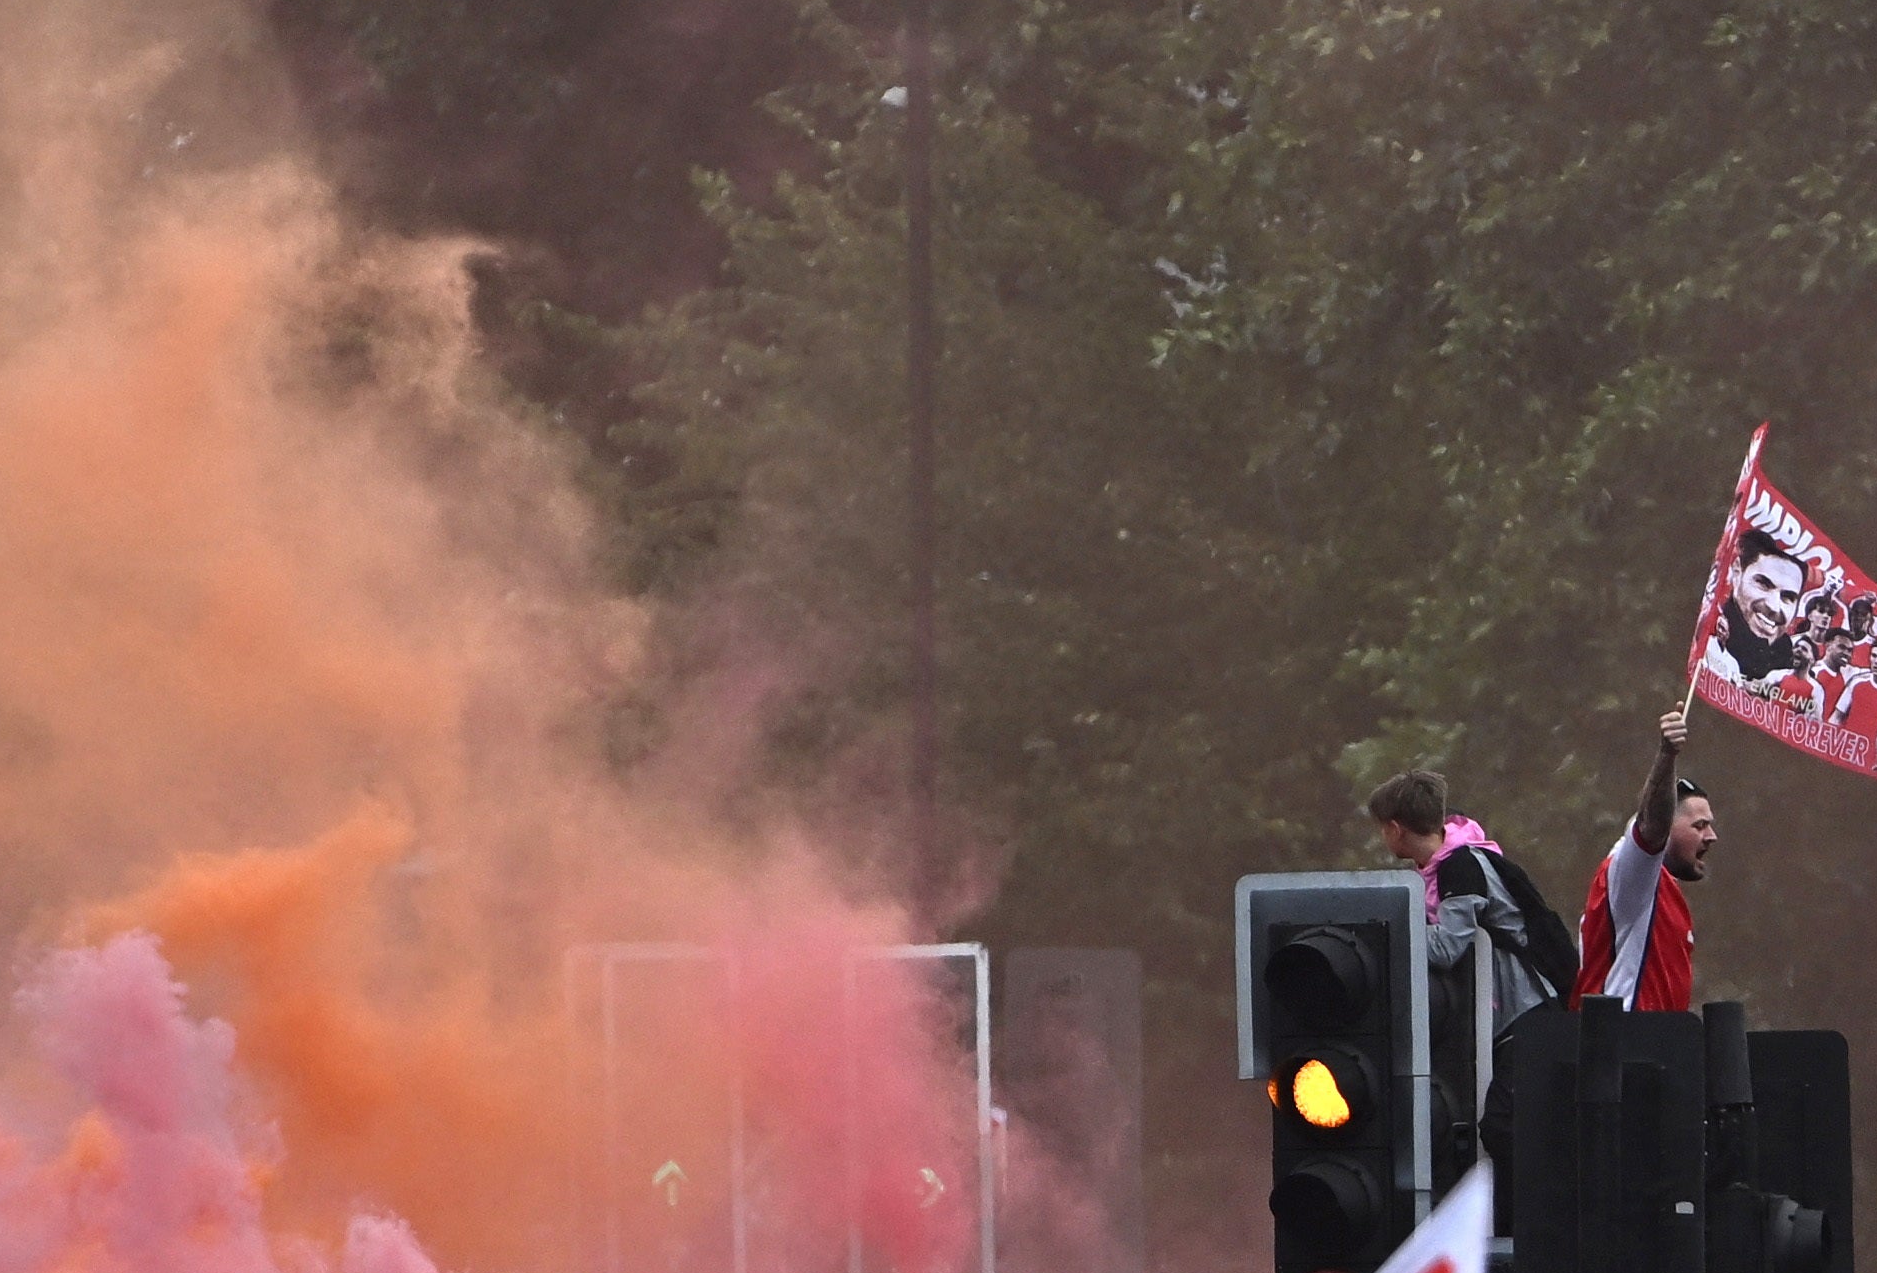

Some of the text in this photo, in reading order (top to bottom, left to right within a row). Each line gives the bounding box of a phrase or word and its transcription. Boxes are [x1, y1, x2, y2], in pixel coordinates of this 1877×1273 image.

[1708, 673, 1780, 733] LONDON
[1782, 708, 1870, 767] FOREVER
[1750, 682, 1816, 713] ENGLAND
